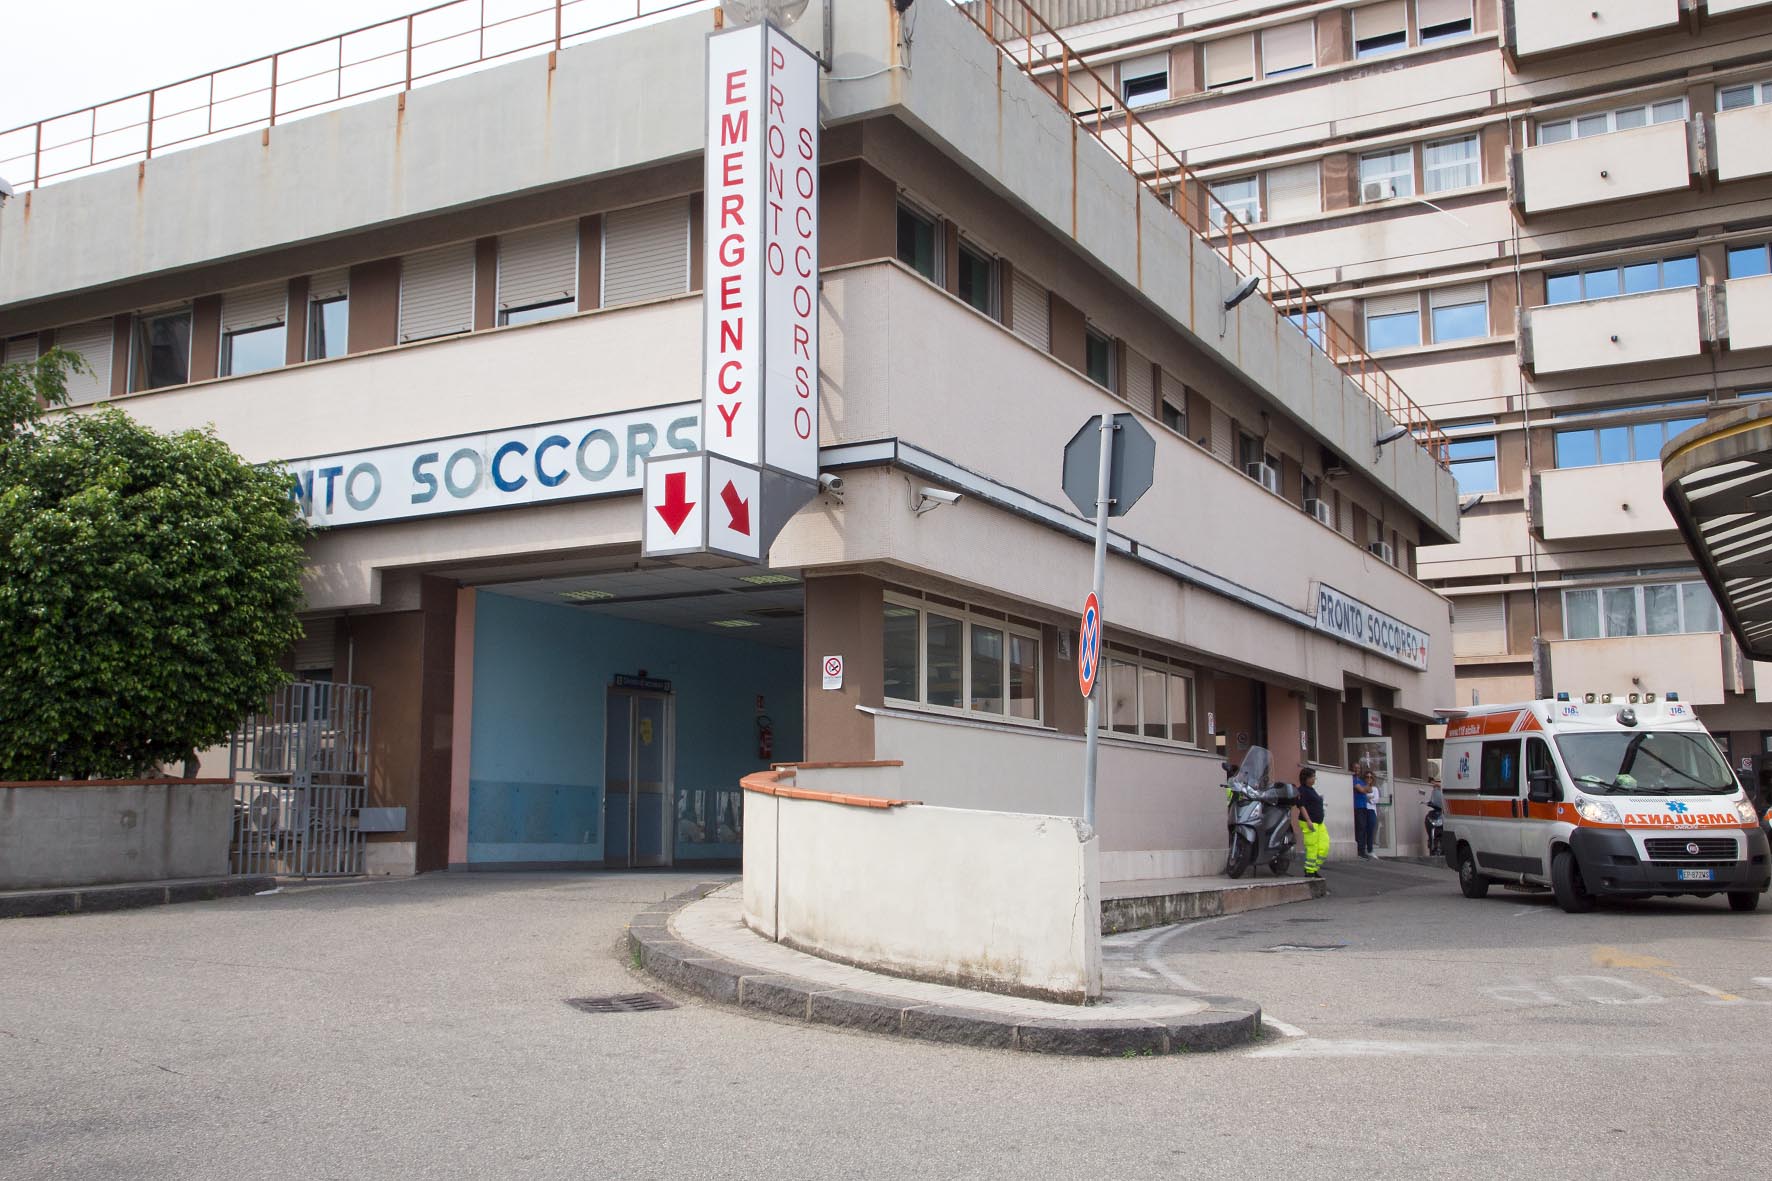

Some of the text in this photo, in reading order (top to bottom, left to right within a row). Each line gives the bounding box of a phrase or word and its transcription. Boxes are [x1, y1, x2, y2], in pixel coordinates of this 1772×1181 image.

[716, 68, 748, 438] EMERGENCY
[767, 46, 785, 277] PRONTO
[793, 127, 813, 440] SOCCORSO
[287, 415, 699, 517] NTO SOCCORS
[1319, 591, 1418, 661] PRONTO SOCCORSO
